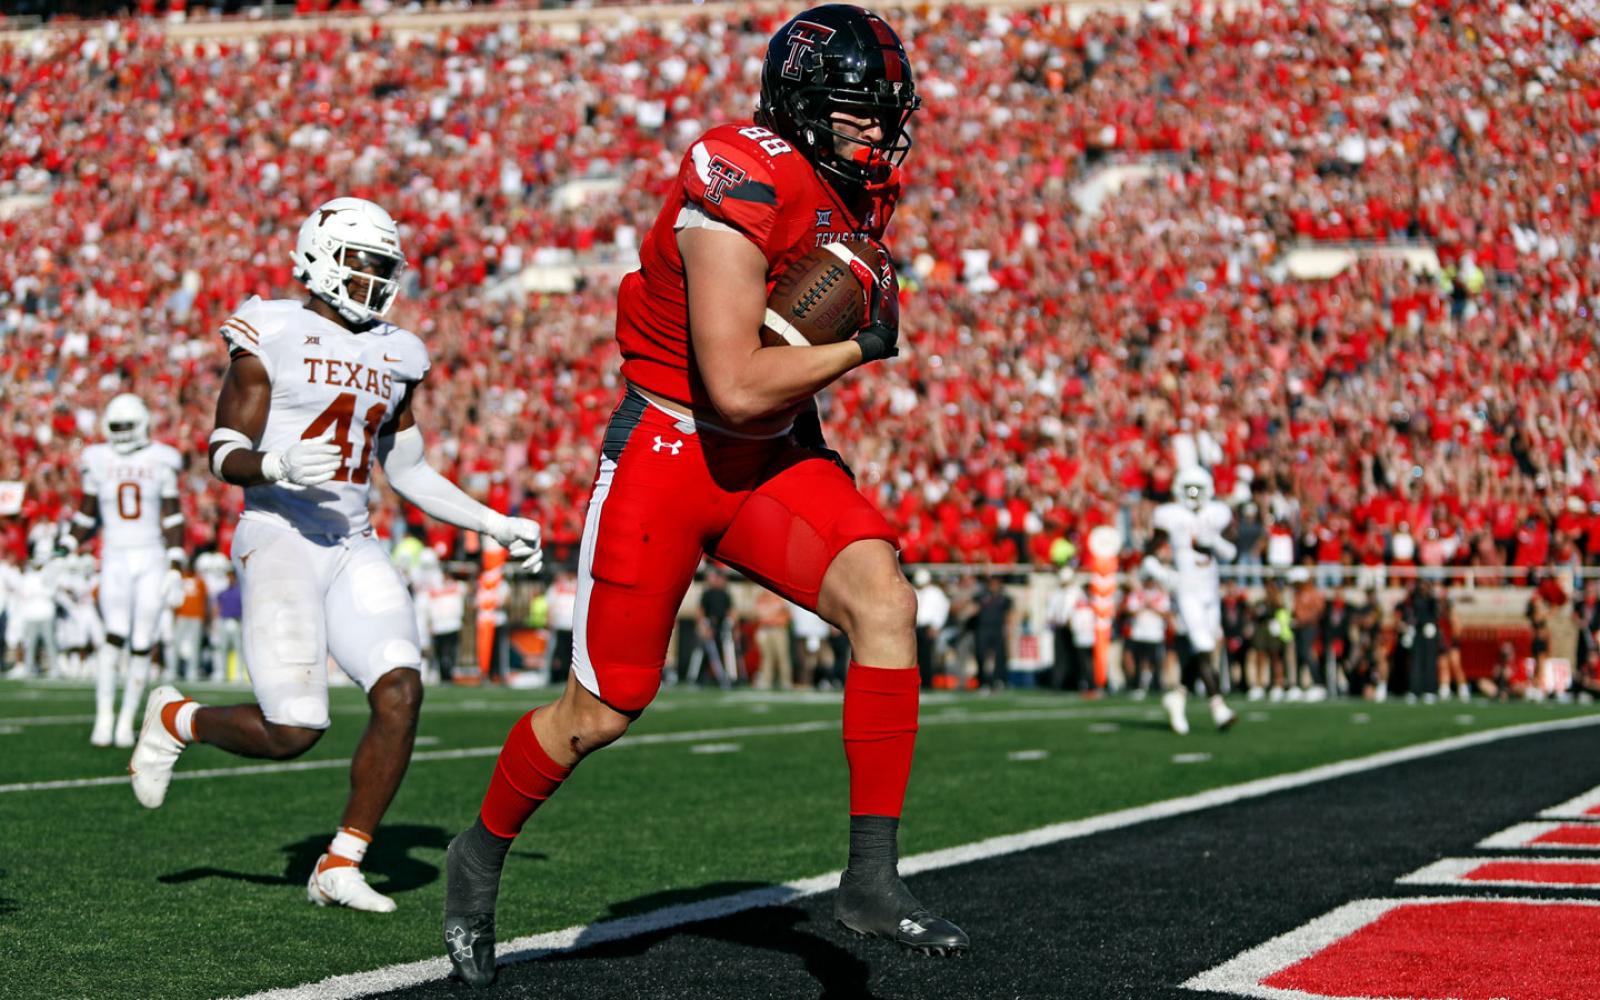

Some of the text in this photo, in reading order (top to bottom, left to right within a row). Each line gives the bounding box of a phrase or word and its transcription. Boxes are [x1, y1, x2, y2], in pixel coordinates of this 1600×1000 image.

[738, 126, 792, 157] 88
[304, 357, 393, 401] TEXAS
[300, 392, 387, 484] 41
[117, 482, 142, 520] 0
